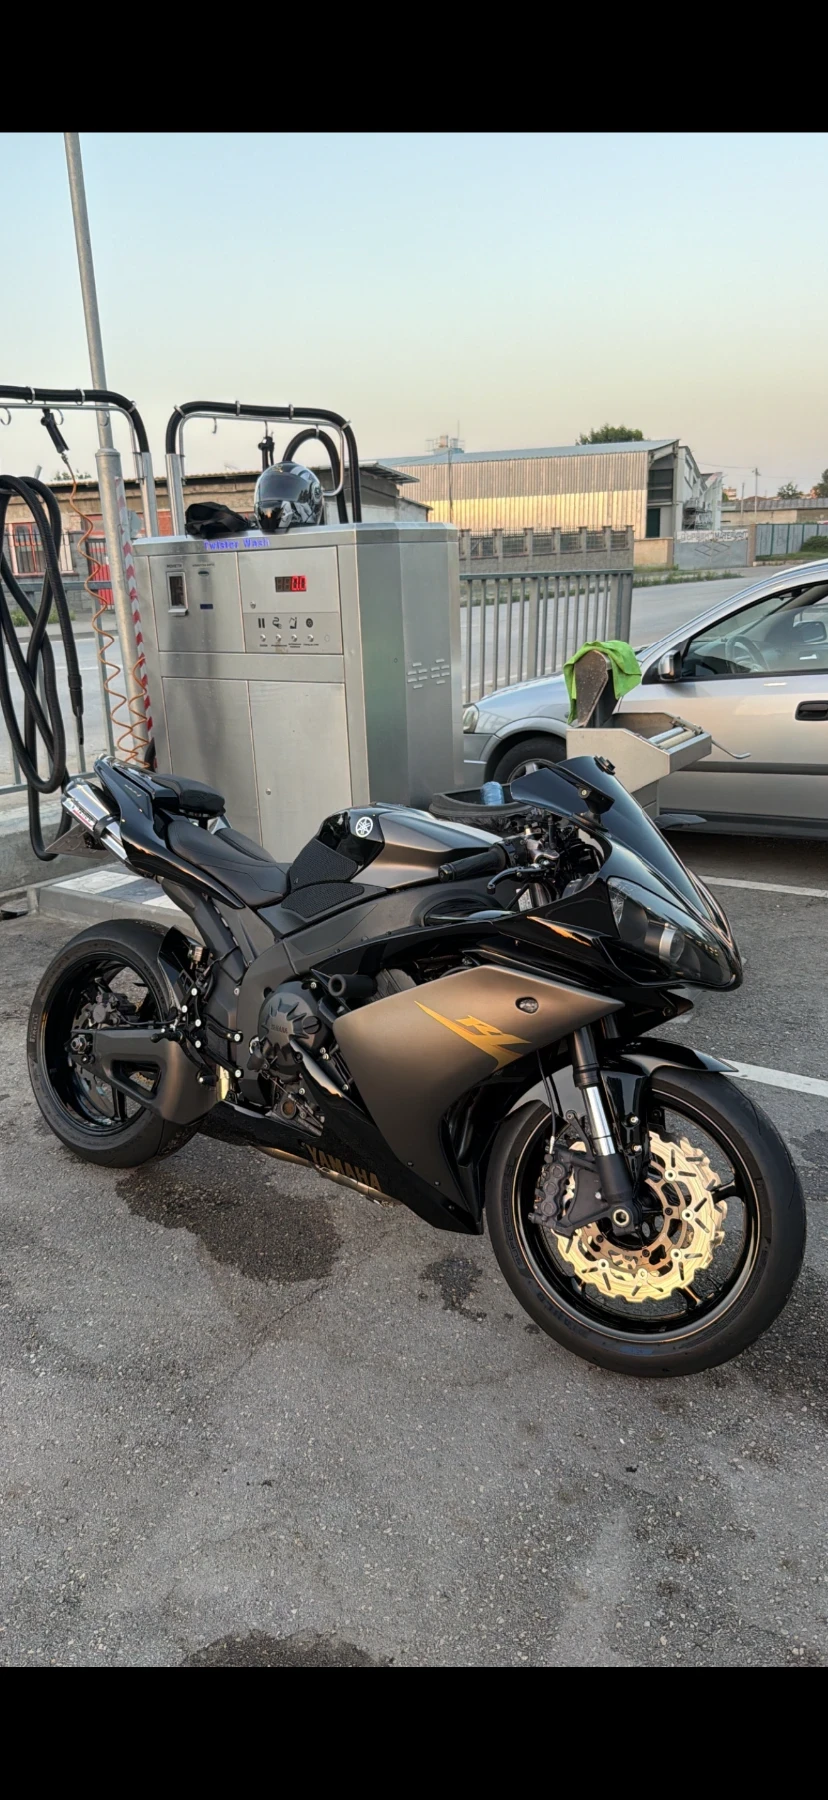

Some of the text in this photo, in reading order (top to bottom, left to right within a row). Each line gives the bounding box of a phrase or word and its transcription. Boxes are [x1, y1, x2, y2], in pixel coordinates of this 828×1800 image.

[204, 537, 269, 549] Twister Wash
[305, 1143, 382, 1191] YAMAHA
